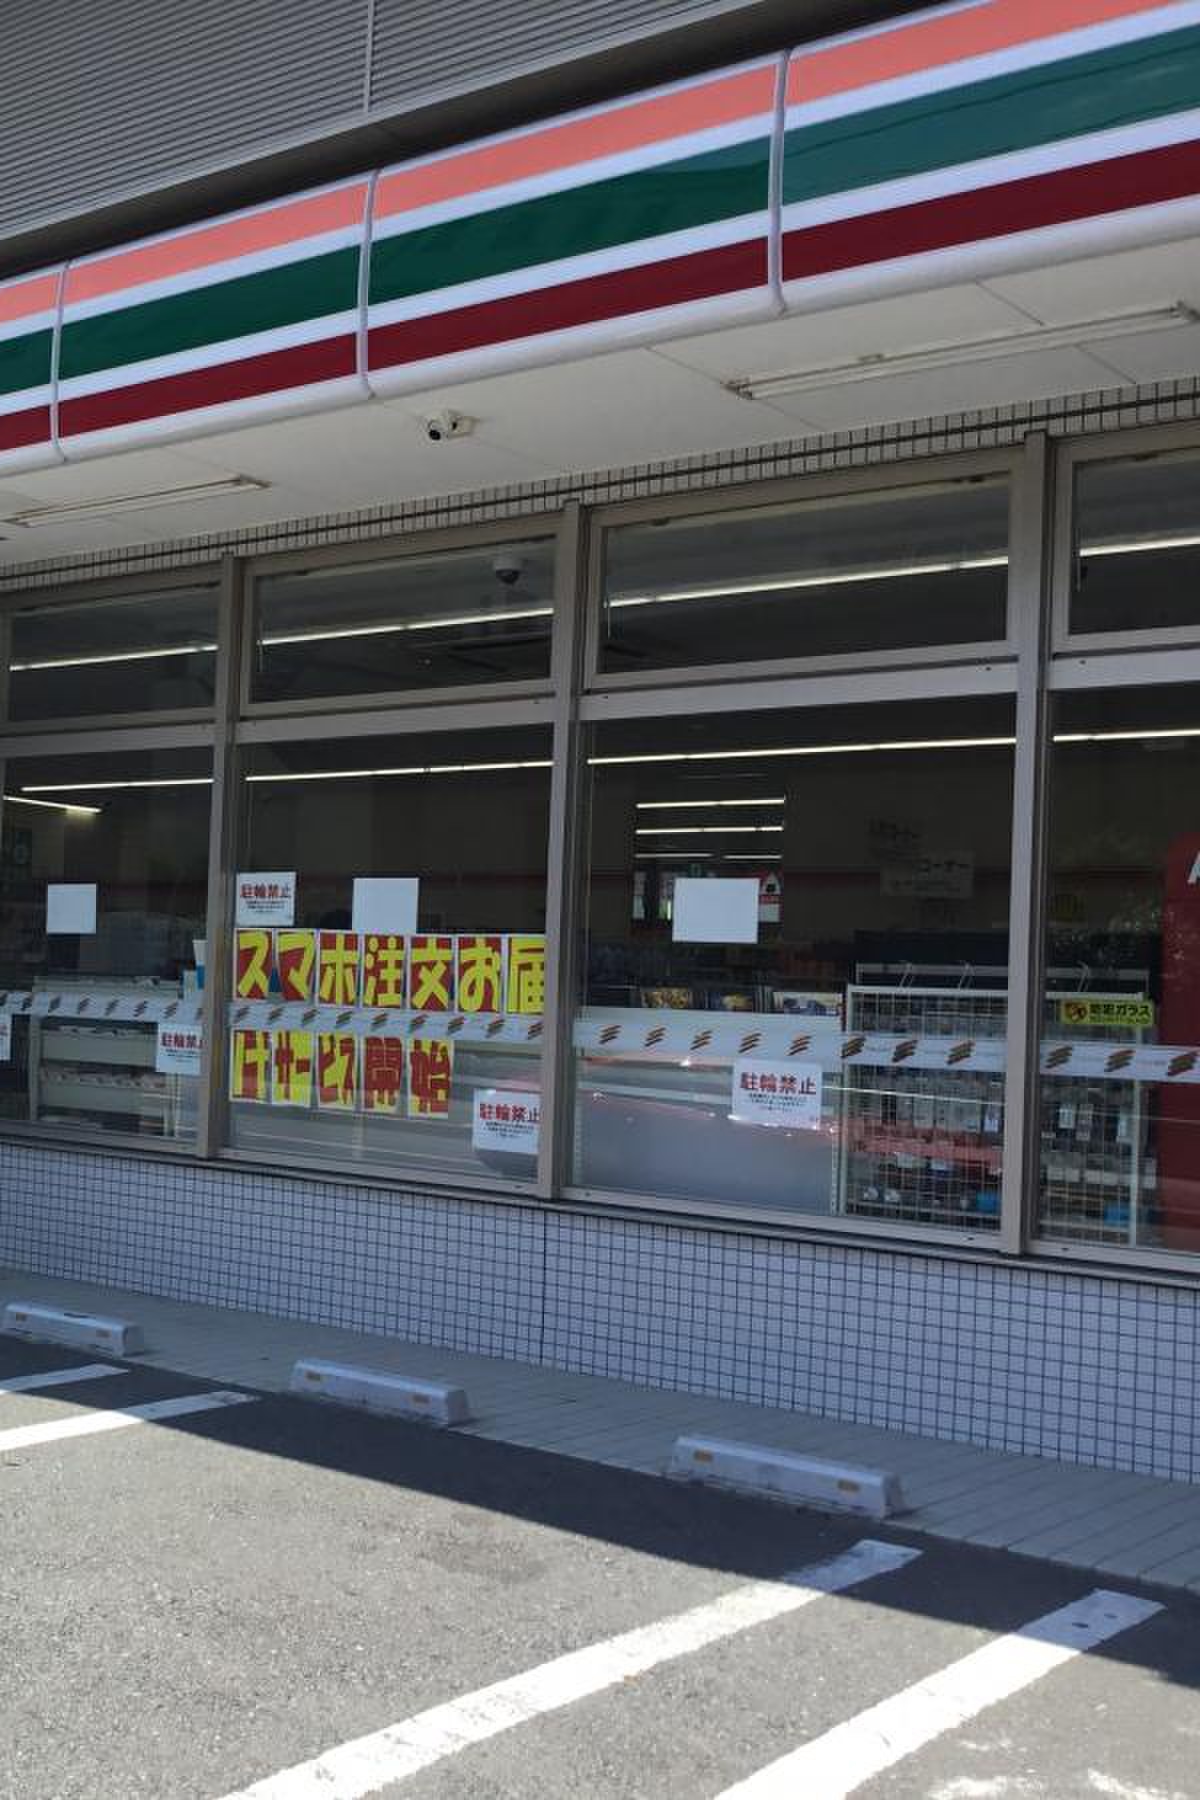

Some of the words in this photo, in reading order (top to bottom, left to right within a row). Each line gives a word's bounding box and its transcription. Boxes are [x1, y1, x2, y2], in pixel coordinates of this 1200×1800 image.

[238, 930, 544, 1014] スマホ注文お届
